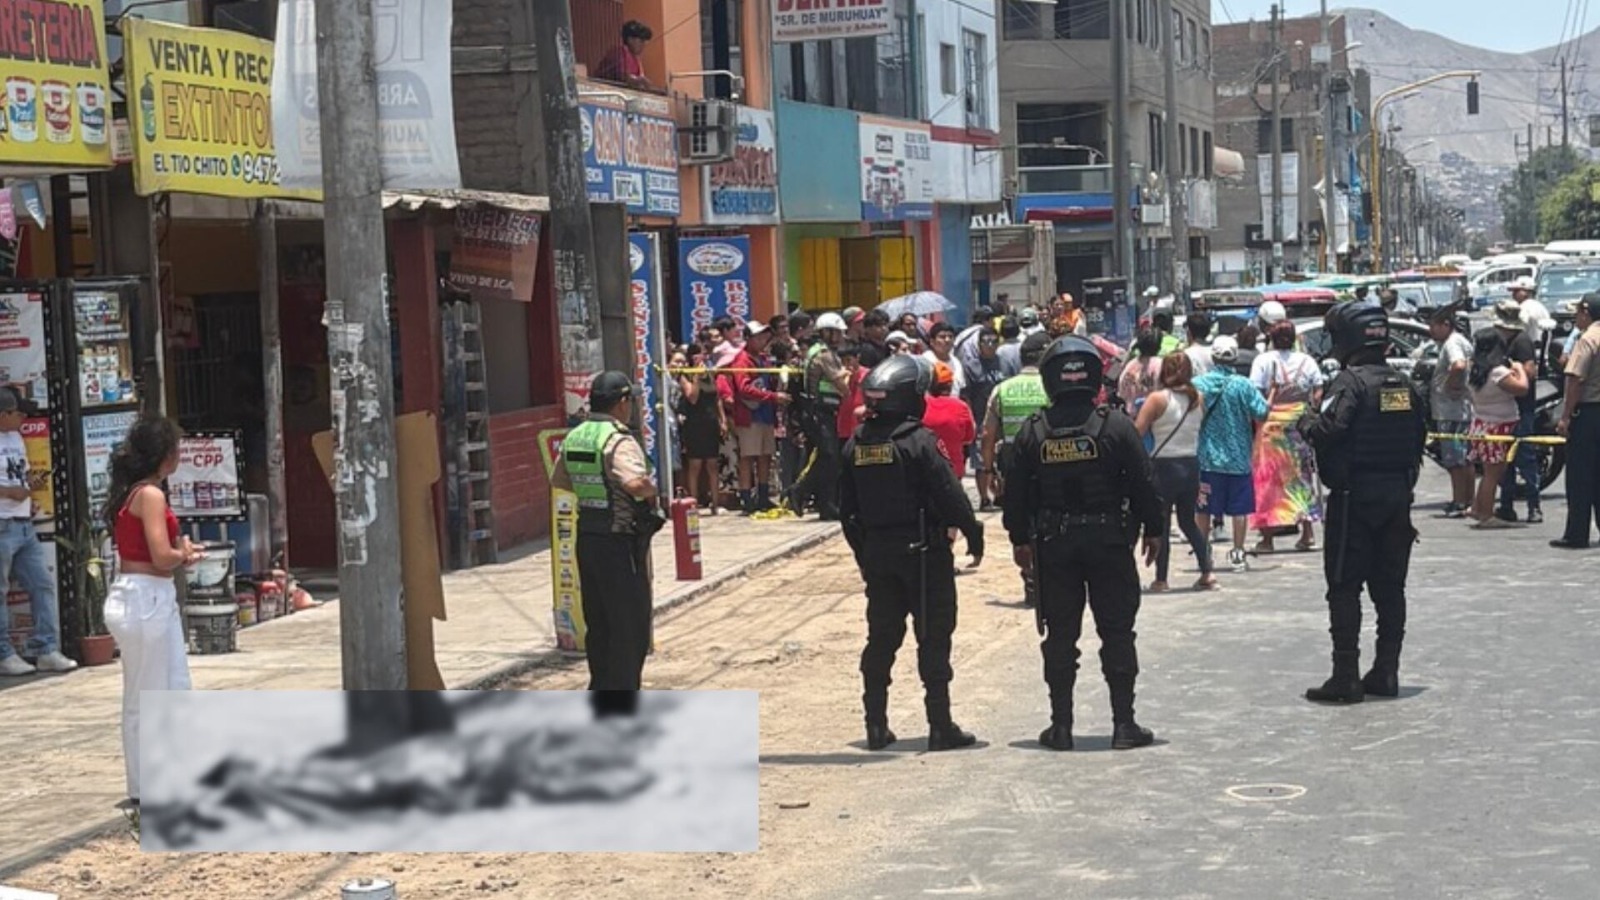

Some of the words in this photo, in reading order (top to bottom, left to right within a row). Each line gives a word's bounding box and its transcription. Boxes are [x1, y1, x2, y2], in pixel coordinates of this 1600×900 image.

[801, 12, 817, 24] DE
[149, 38, 214, 77] VENTA
[217, 48, 230, 79] Y
[235, 50, 273, 85] REC
[594, 109, 622, 166] SAN
[623, 113, 678, 173] GABRIEL
[153, 153, 168, 172] EL
[171, 154, 190, 174] TIO
[193, 156, 228, 176] CHITO
[21, 422, 47, 434] CPP
[193, 453, 224, 468] CPP
